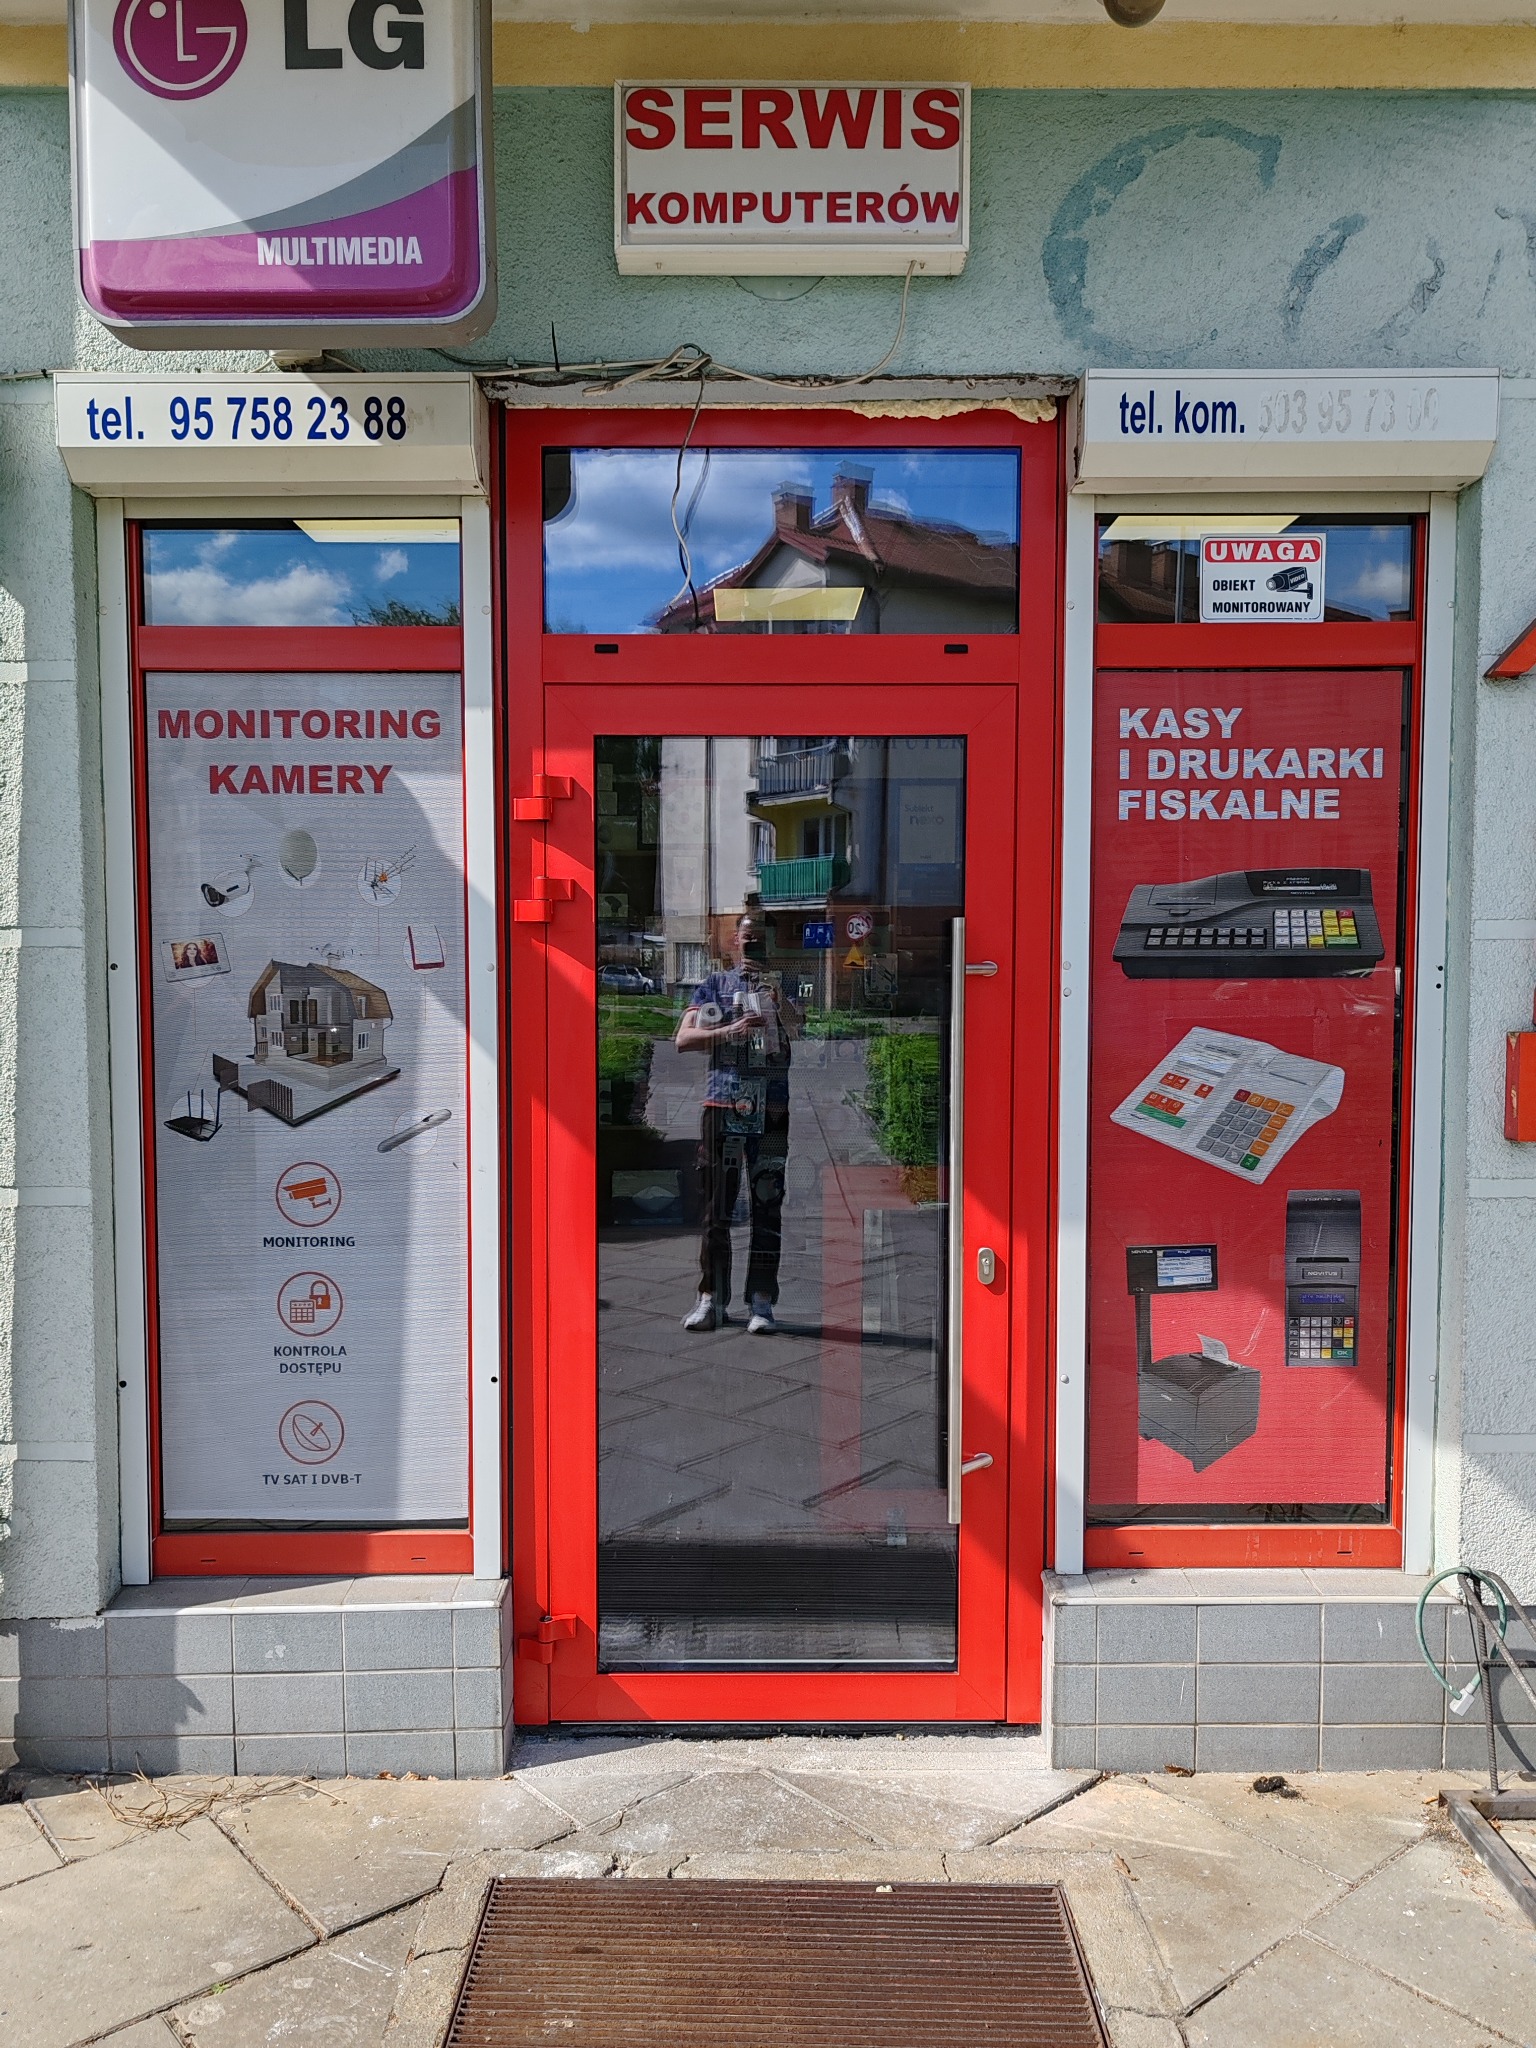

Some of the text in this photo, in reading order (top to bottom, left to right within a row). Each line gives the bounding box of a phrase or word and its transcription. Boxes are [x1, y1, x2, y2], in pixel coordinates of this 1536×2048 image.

[283, 0, 425, 71] LG
[625, 88, 960, 150] SERWIS
[626, 184, 960, 225] KOMPUTERÓW
[257, 236, 423, 266] MULTIMEDIA
[86, 396, 145, 440] tel.
[169, 396, 214, 440] 95
[226, 396, 293, 440] 758
[306, 396, 350, 440] 23
[363, 396, 407, 440] 88
[1119, 390, 1163, 434] tel.
[1174, 389, 1246, 434] kom.
[1317, 388, 1352, 434] 95
[1210, 542, 1316, 561] UWAGA
[1212, 579, 1256, 591] OBIEKT
[1289, 573, 1306, 584] VIDEO
[1212, 601, 1311, 613] MONITOROWANY
[158, 709, 441, 740] MONITORING
[1118, 707, 1243, 739] KASY
[1119, 747, 1384, 780] I DRUKARKI
[209, 764, 393, 795] KAMERY
[1118, 788, 1340, 821] FISKALNE
[263, 1236, 356, 1248] MONITORING
[273, 1345, 347, 1357] KONTROLA
[279, 1363, 342, 1376] DOSTĘPU
[262, 1473, 362, 1485] TV SAT I DVB-T
